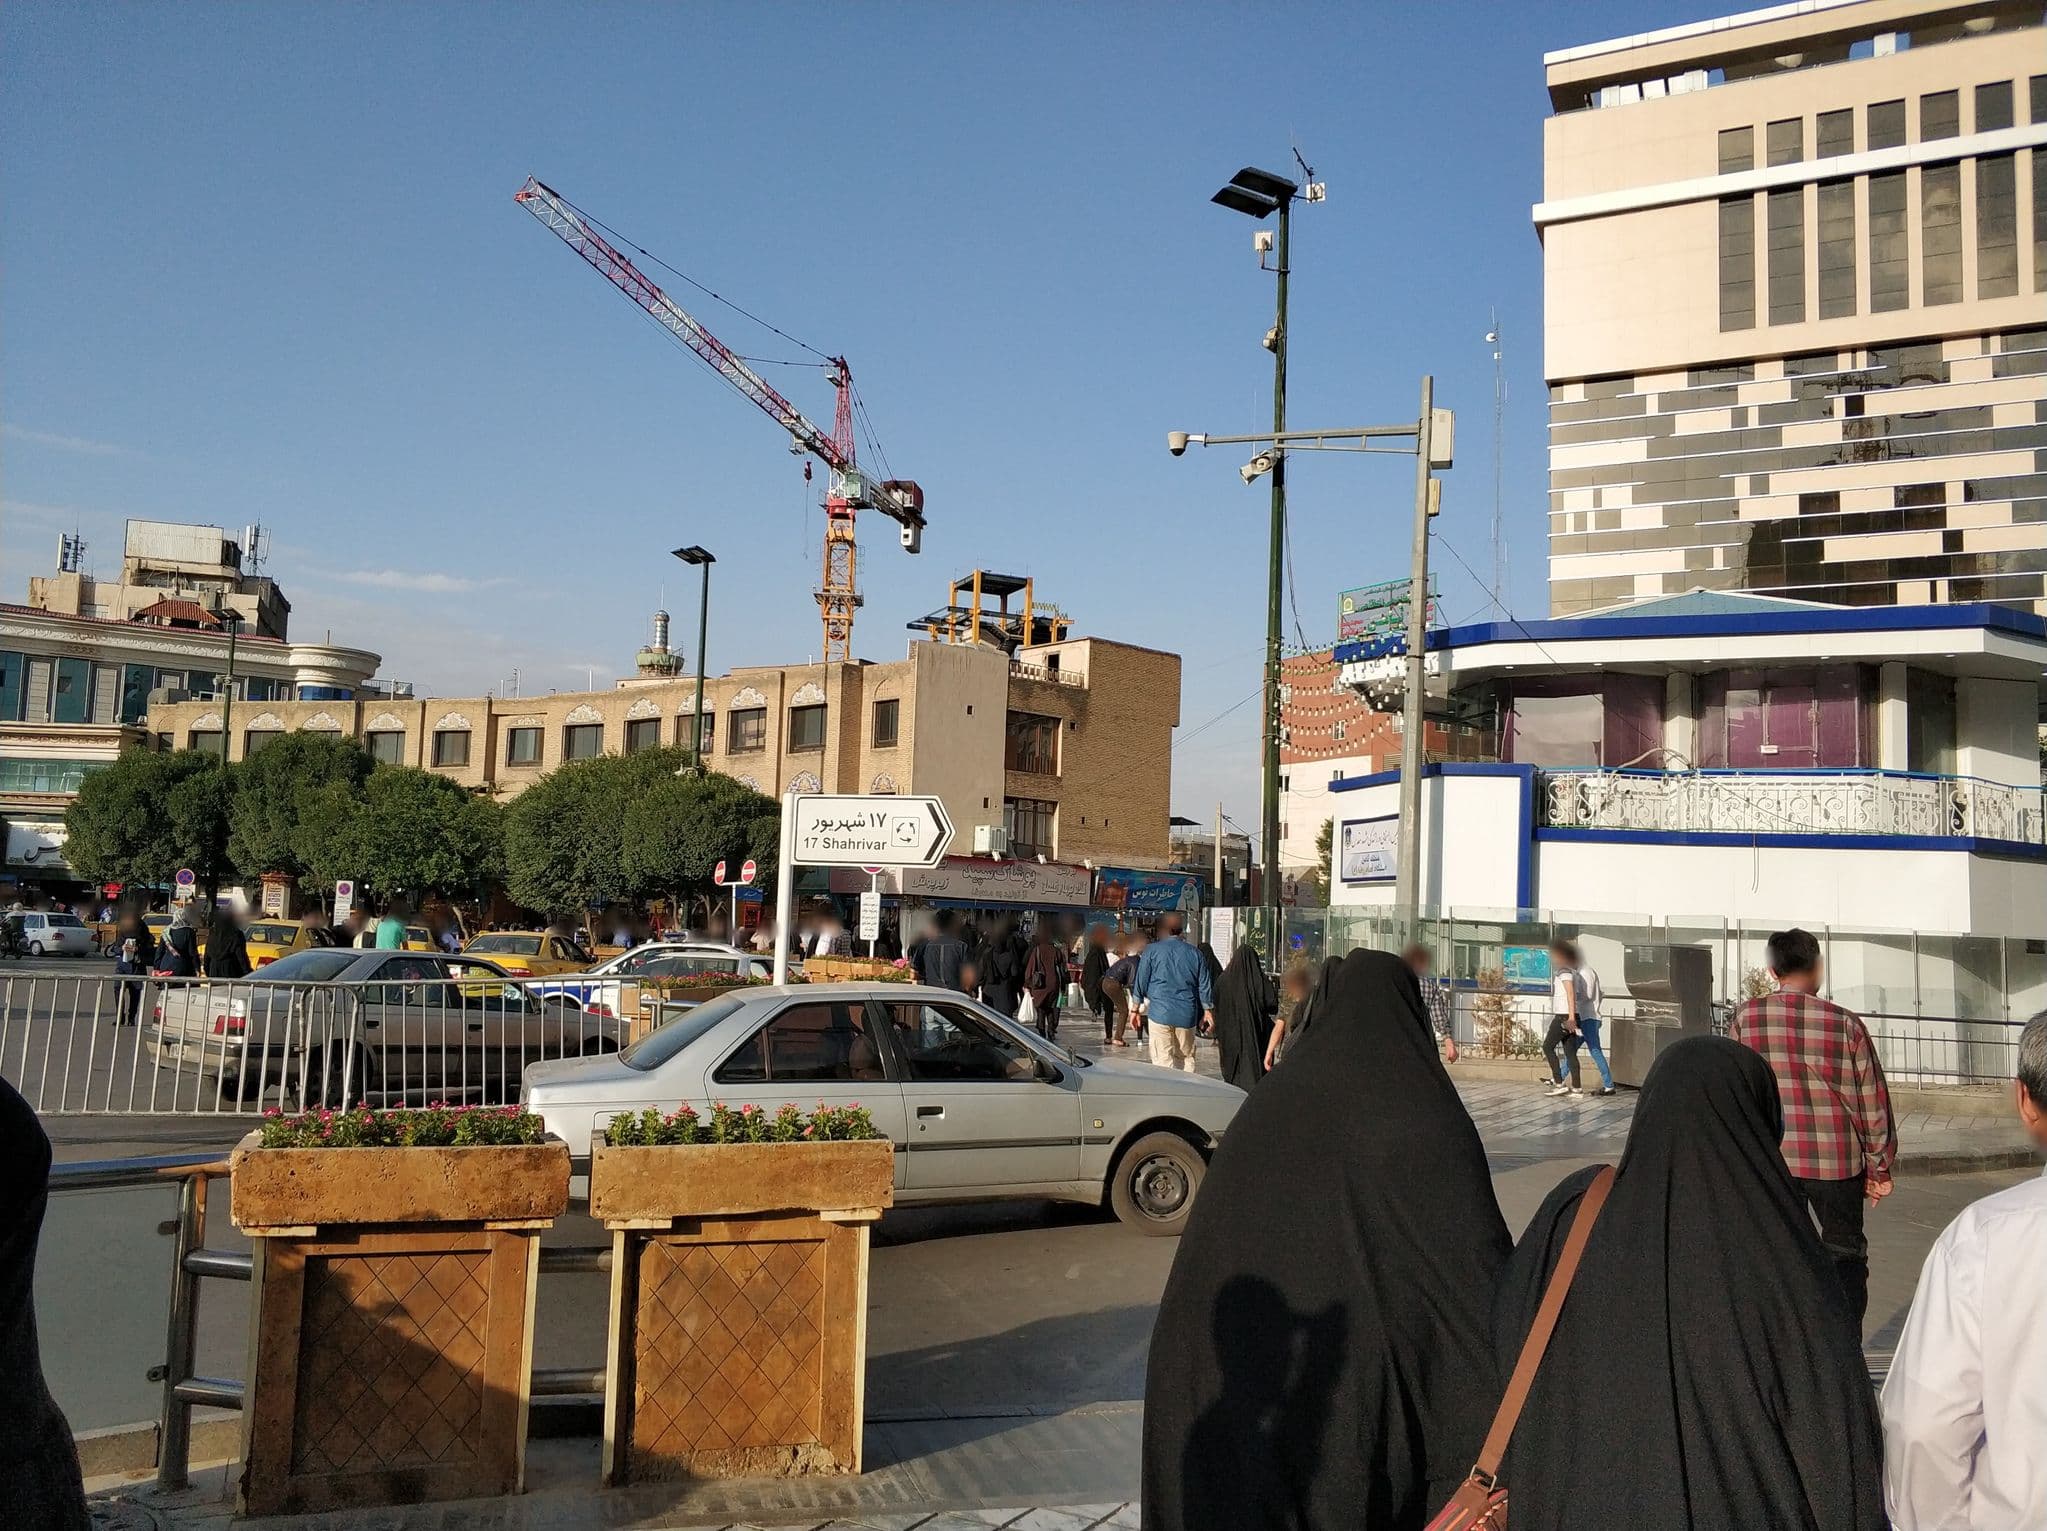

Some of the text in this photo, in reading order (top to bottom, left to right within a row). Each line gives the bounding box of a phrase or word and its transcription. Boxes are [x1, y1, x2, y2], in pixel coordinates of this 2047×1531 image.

[811, 812, 887, 833] ۱۷ شهریور
[803, 837, 887, 850] 17 Shahrivar
[911, 873, 950, 892] زیرپوش
[961, 863, 994, 884] سپید
[994, 864, 1037, 888] پوشاک
